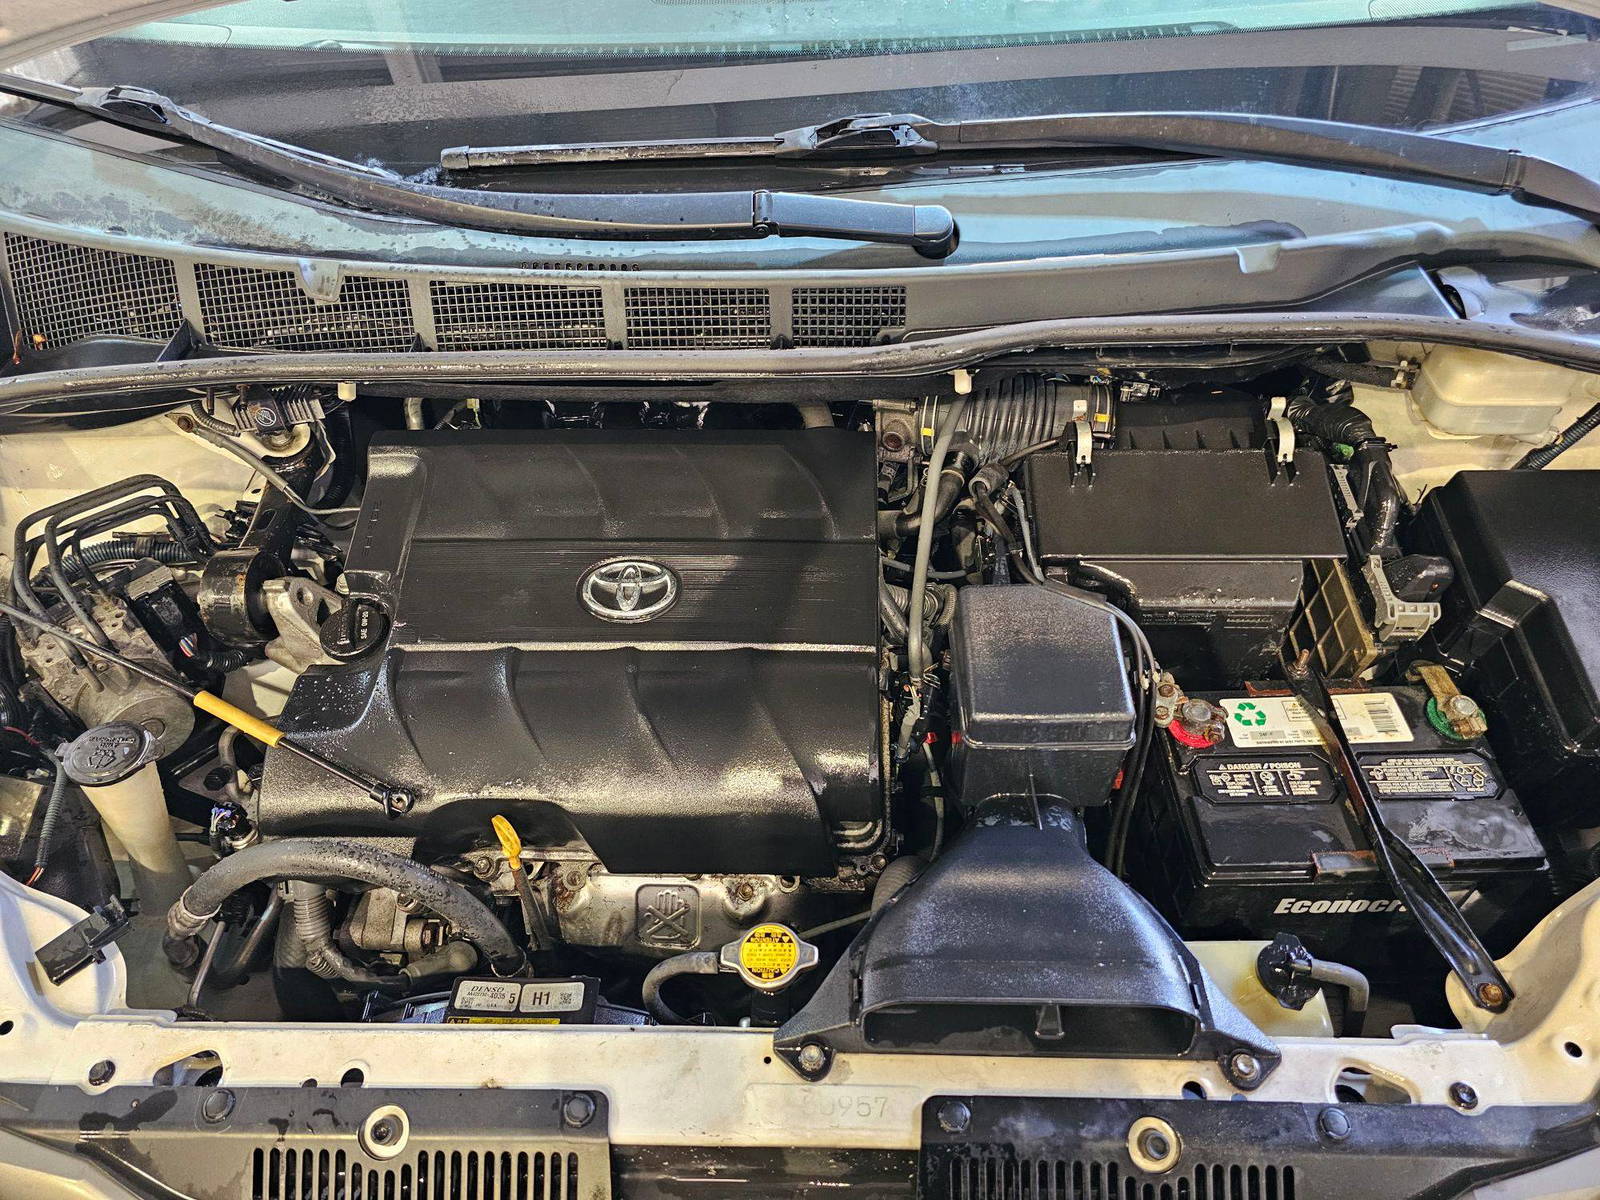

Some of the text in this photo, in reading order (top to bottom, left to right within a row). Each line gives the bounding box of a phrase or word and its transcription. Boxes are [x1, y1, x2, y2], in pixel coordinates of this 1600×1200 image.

[360, 610, 369, 640] SAE 0W-20
[1227, 763, 1262, 771] DANGER
[1273, 898, 1407, 914] Econocr
[508, 993, 516, 1004] 5
[532, 992, 550, 1006] H1
